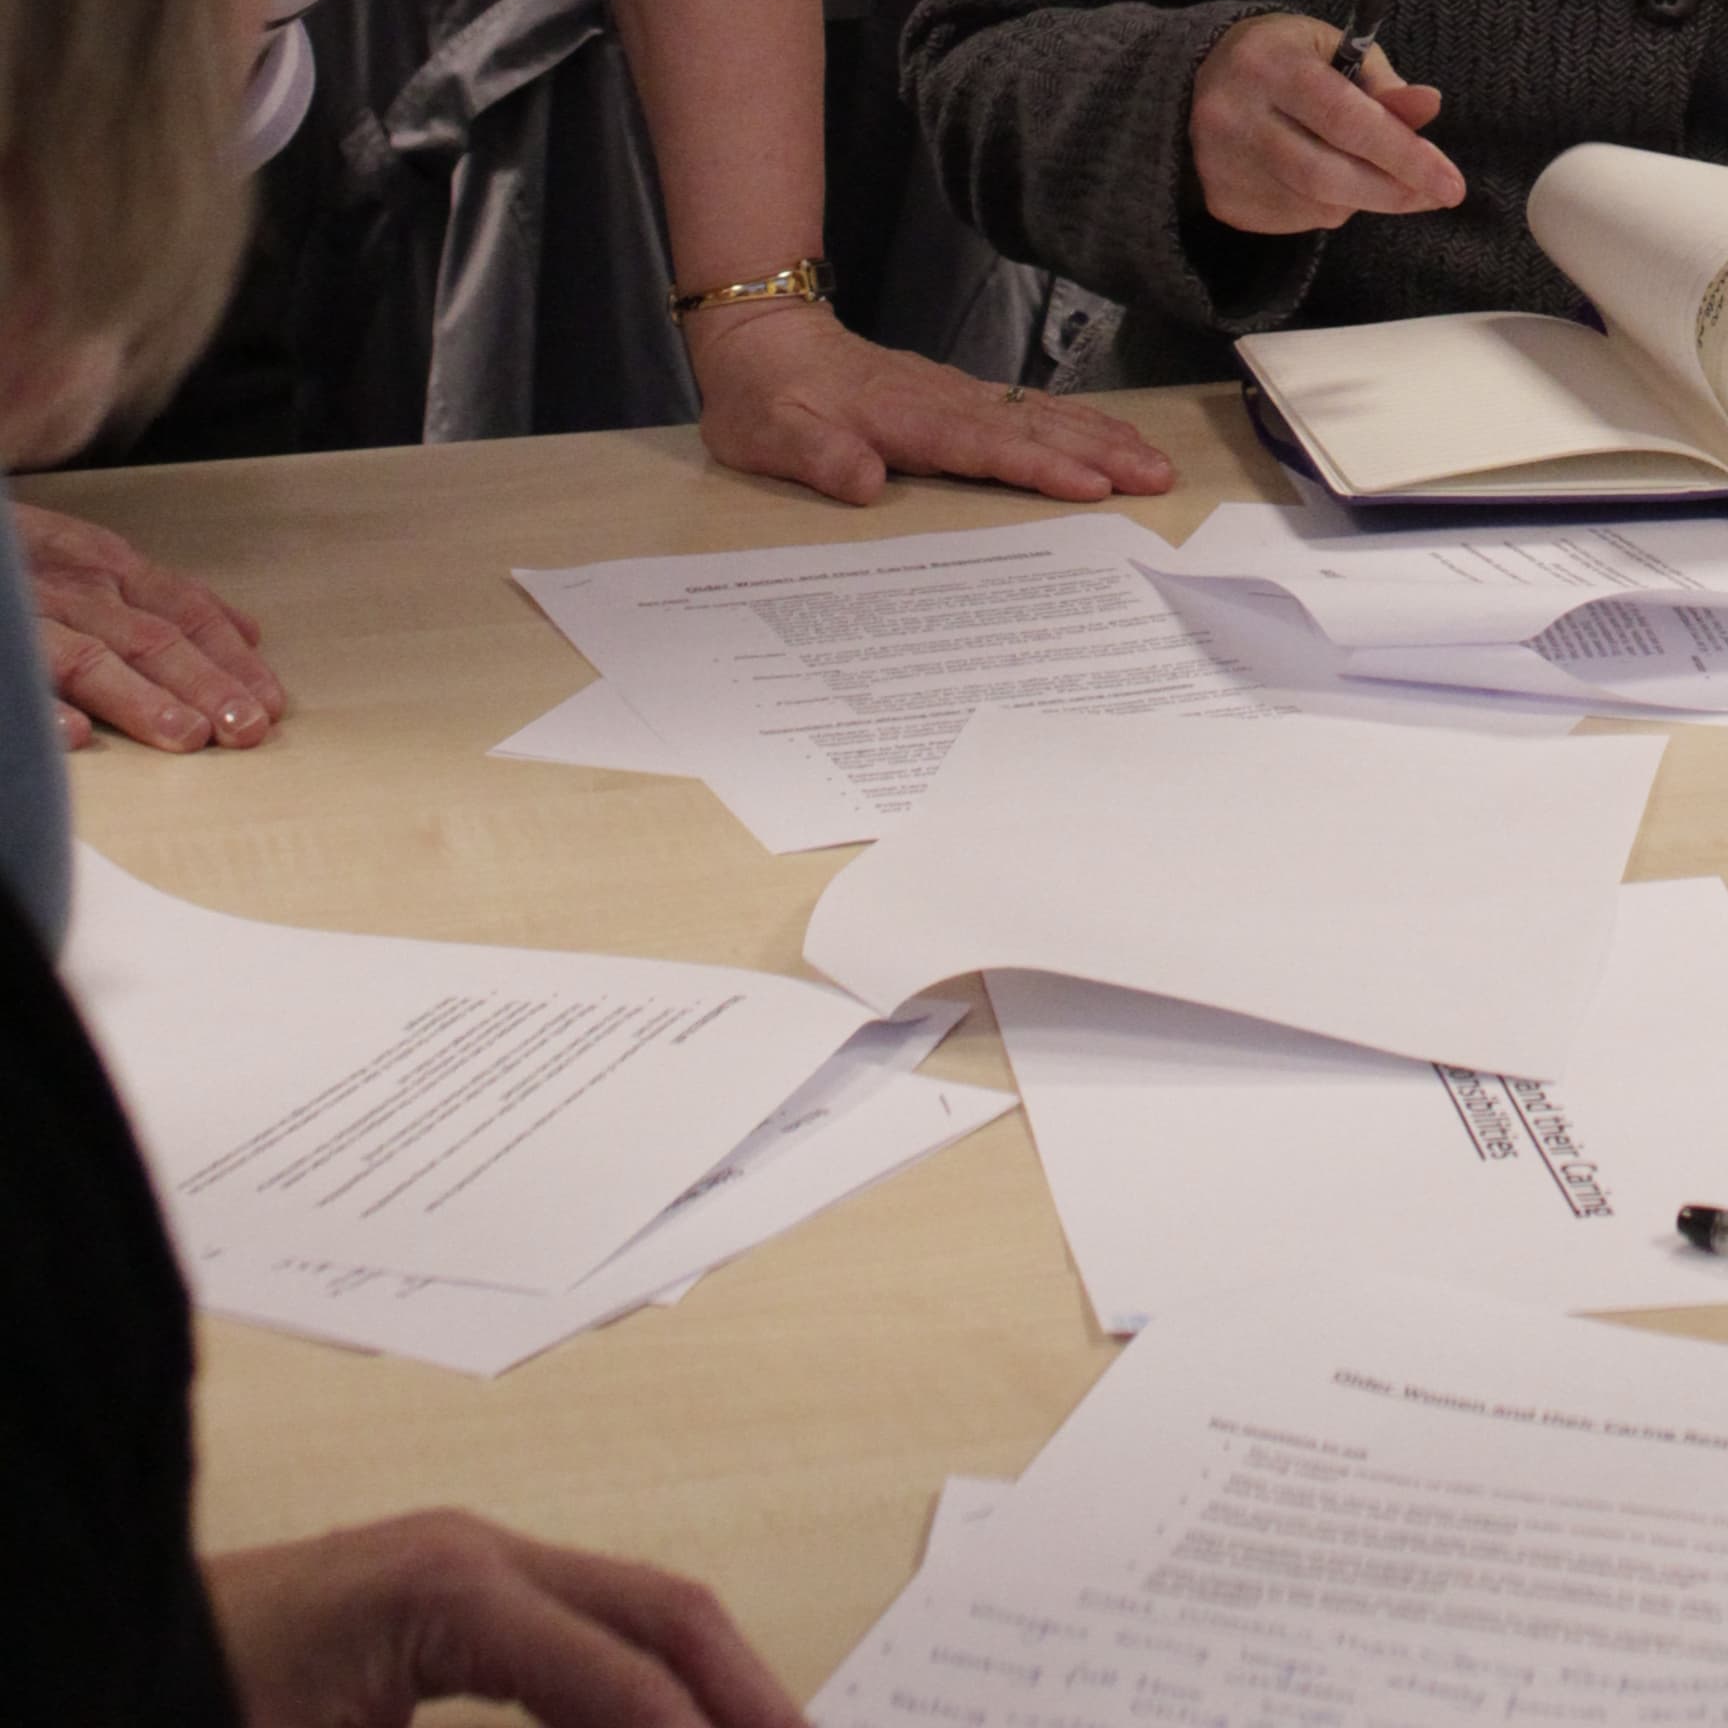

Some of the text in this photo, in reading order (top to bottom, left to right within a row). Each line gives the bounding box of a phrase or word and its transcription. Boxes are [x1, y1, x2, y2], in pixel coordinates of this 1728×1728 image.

[1513, 1080, 1614, 1219] and their Caring
